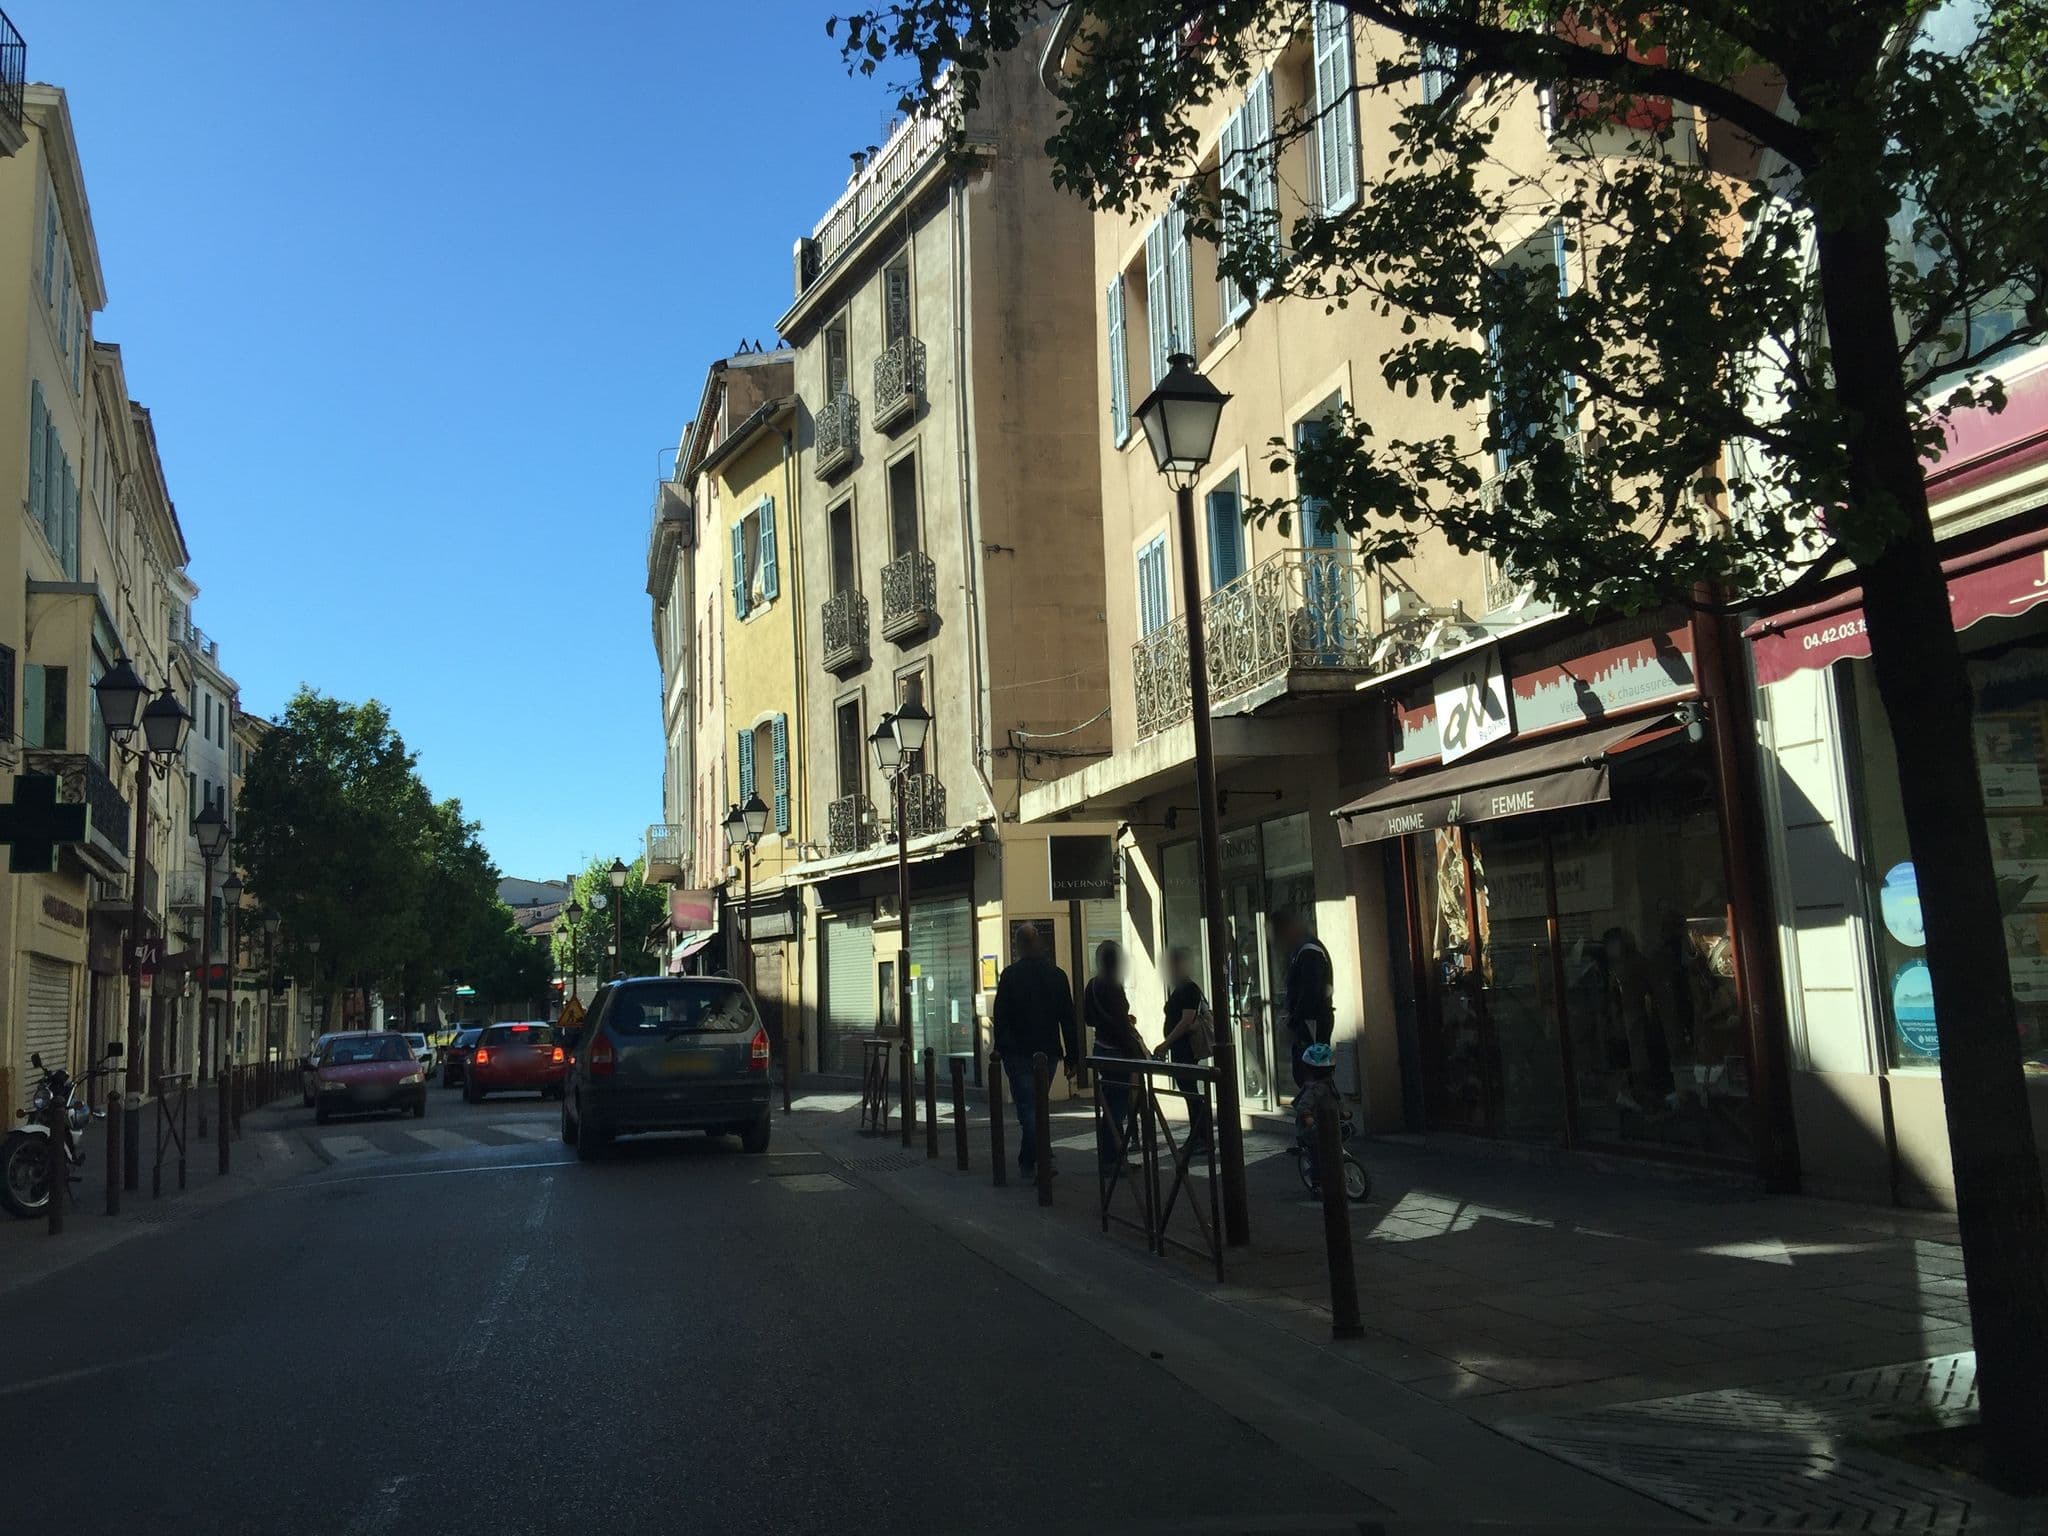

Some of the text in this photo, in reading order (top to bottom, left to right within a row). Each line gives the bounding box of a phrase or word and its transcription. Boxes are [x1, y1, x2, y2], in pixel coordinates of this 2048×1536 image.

[1617, 678, 1673, 700] chaussures
[1388, 812, 1425, 834] HOMME
[1491, 790, 1535, 815] FEMME
[1053, 879, 1113, 889] DEVERNOIS
